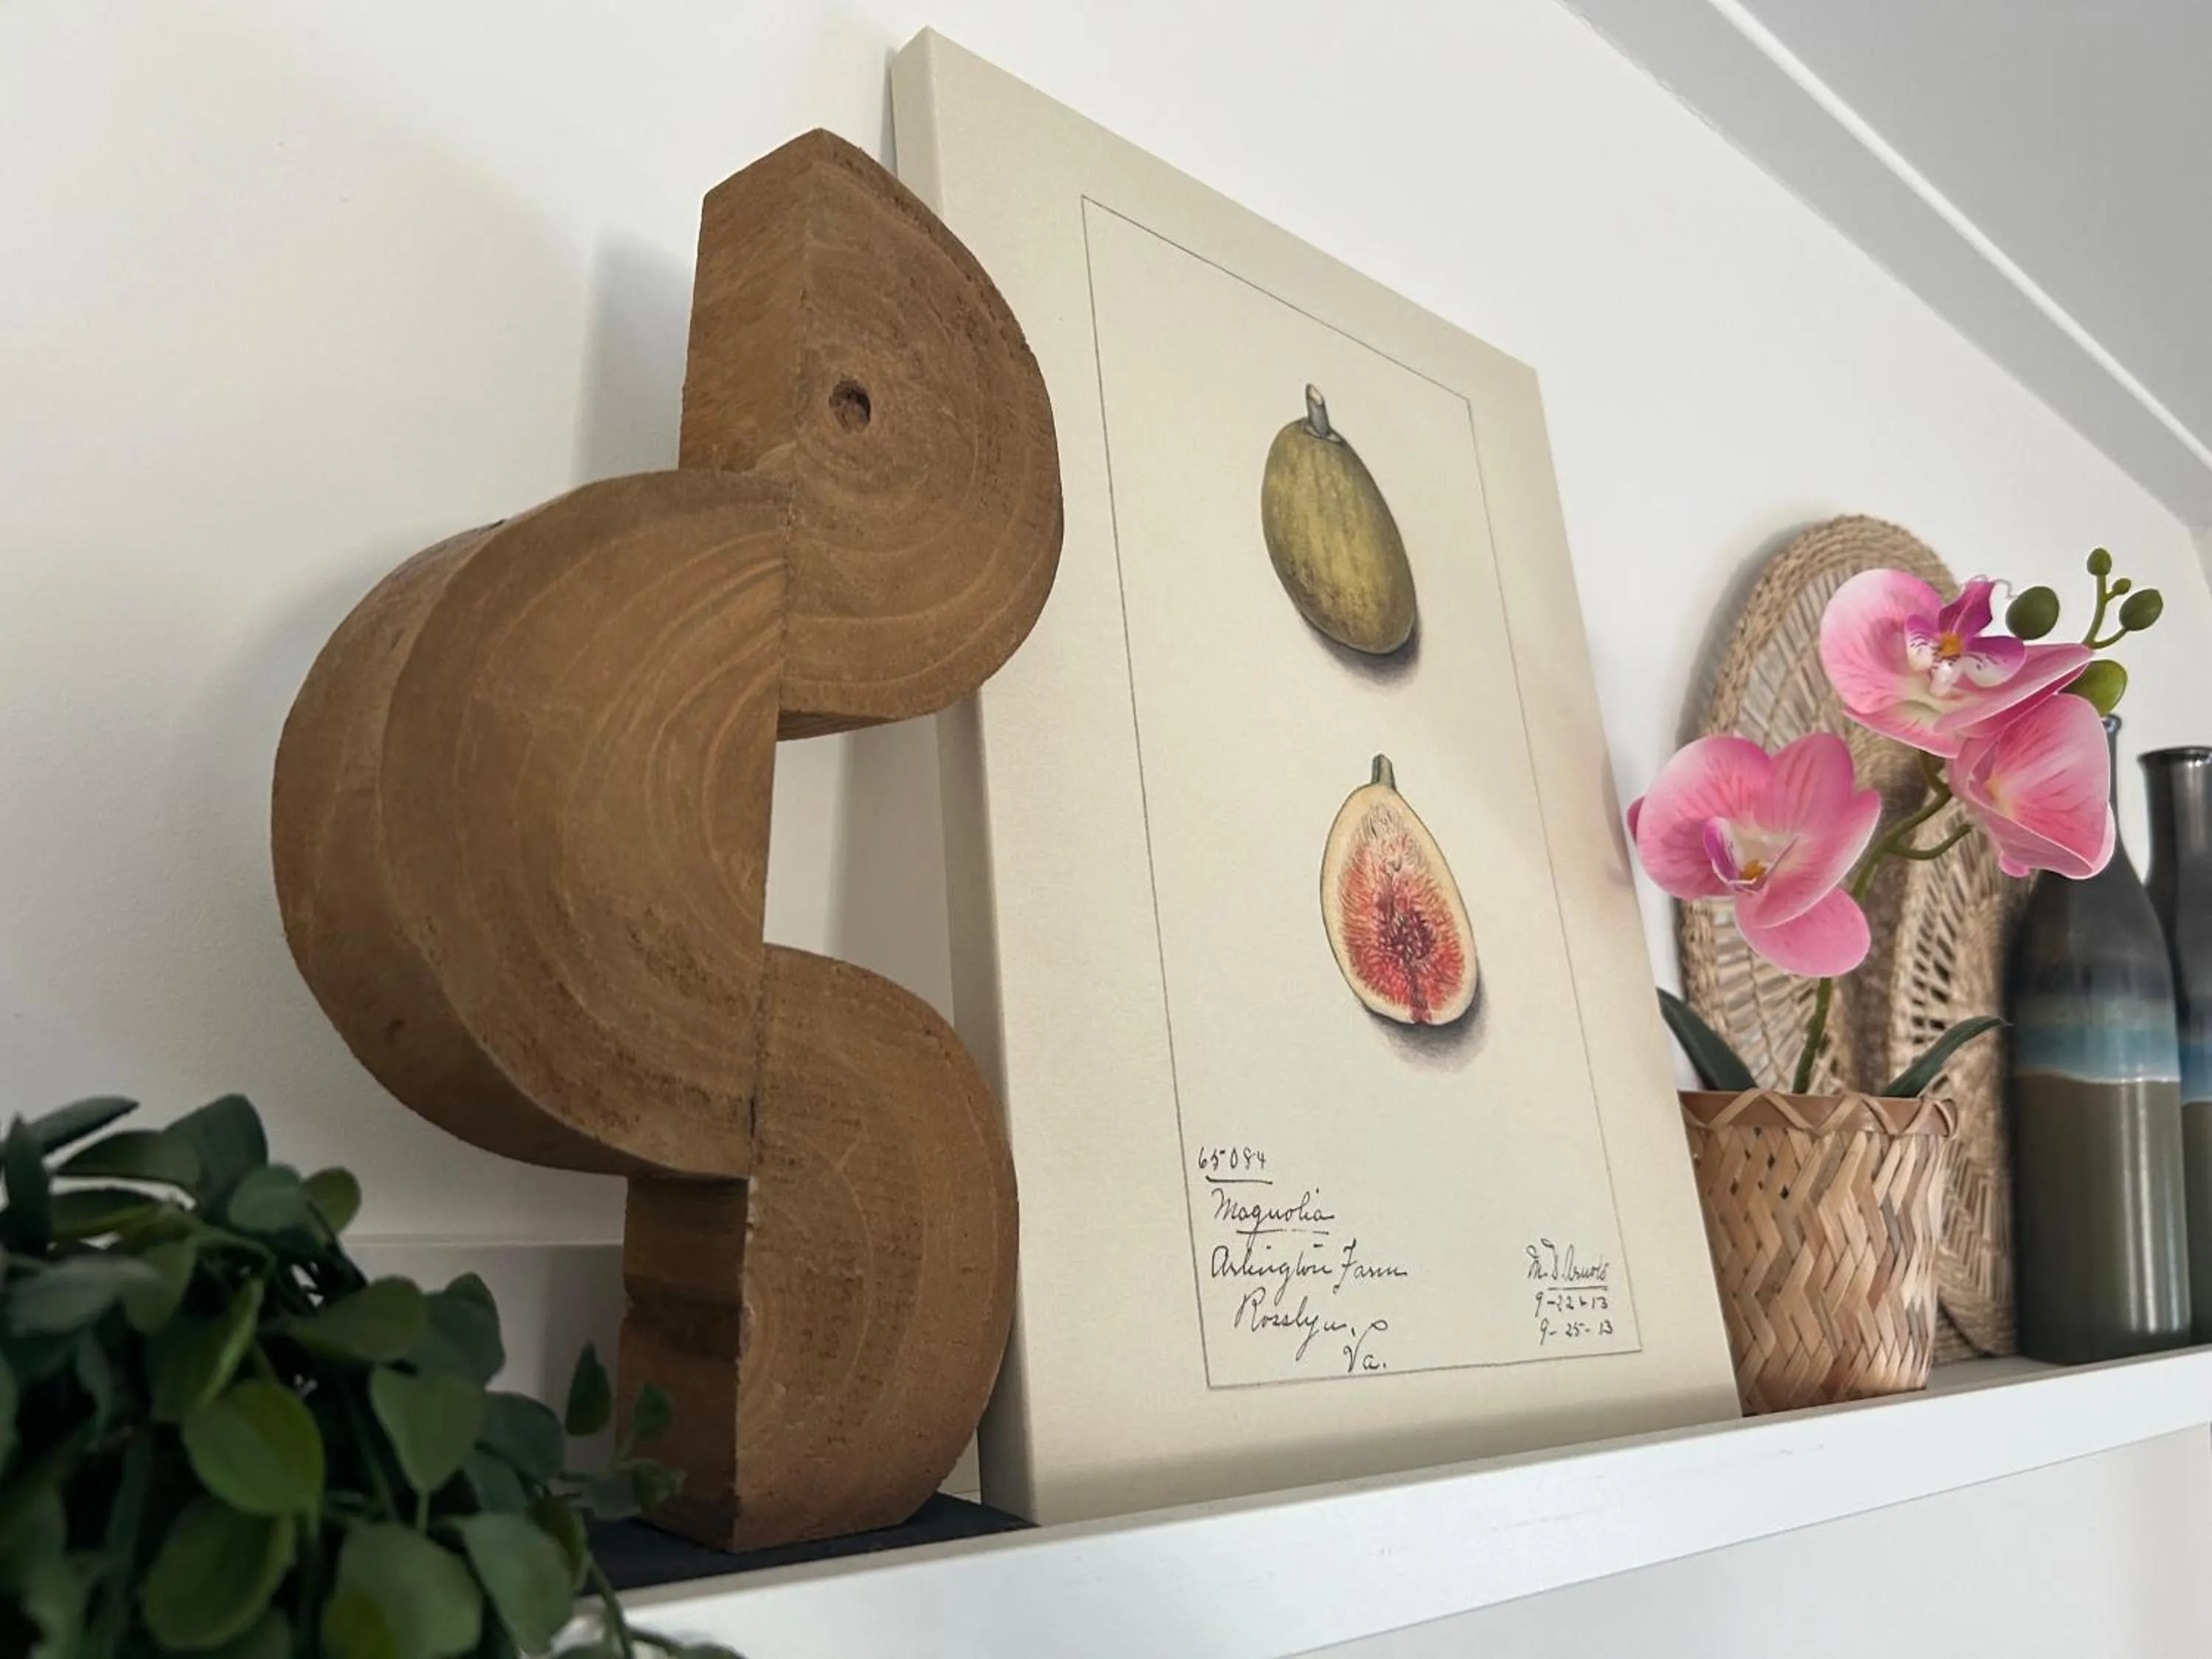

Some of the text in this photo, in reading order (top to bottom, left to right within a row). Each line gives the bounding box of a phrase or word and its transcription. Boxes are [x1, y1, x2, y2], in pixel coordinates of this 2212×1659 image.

[1198, 1146, 1267, 1170] 65084
[1211, 1188, 1335, 1248] Magnolia
[1211, 1238, 1408, 1307] Arlington Farm
